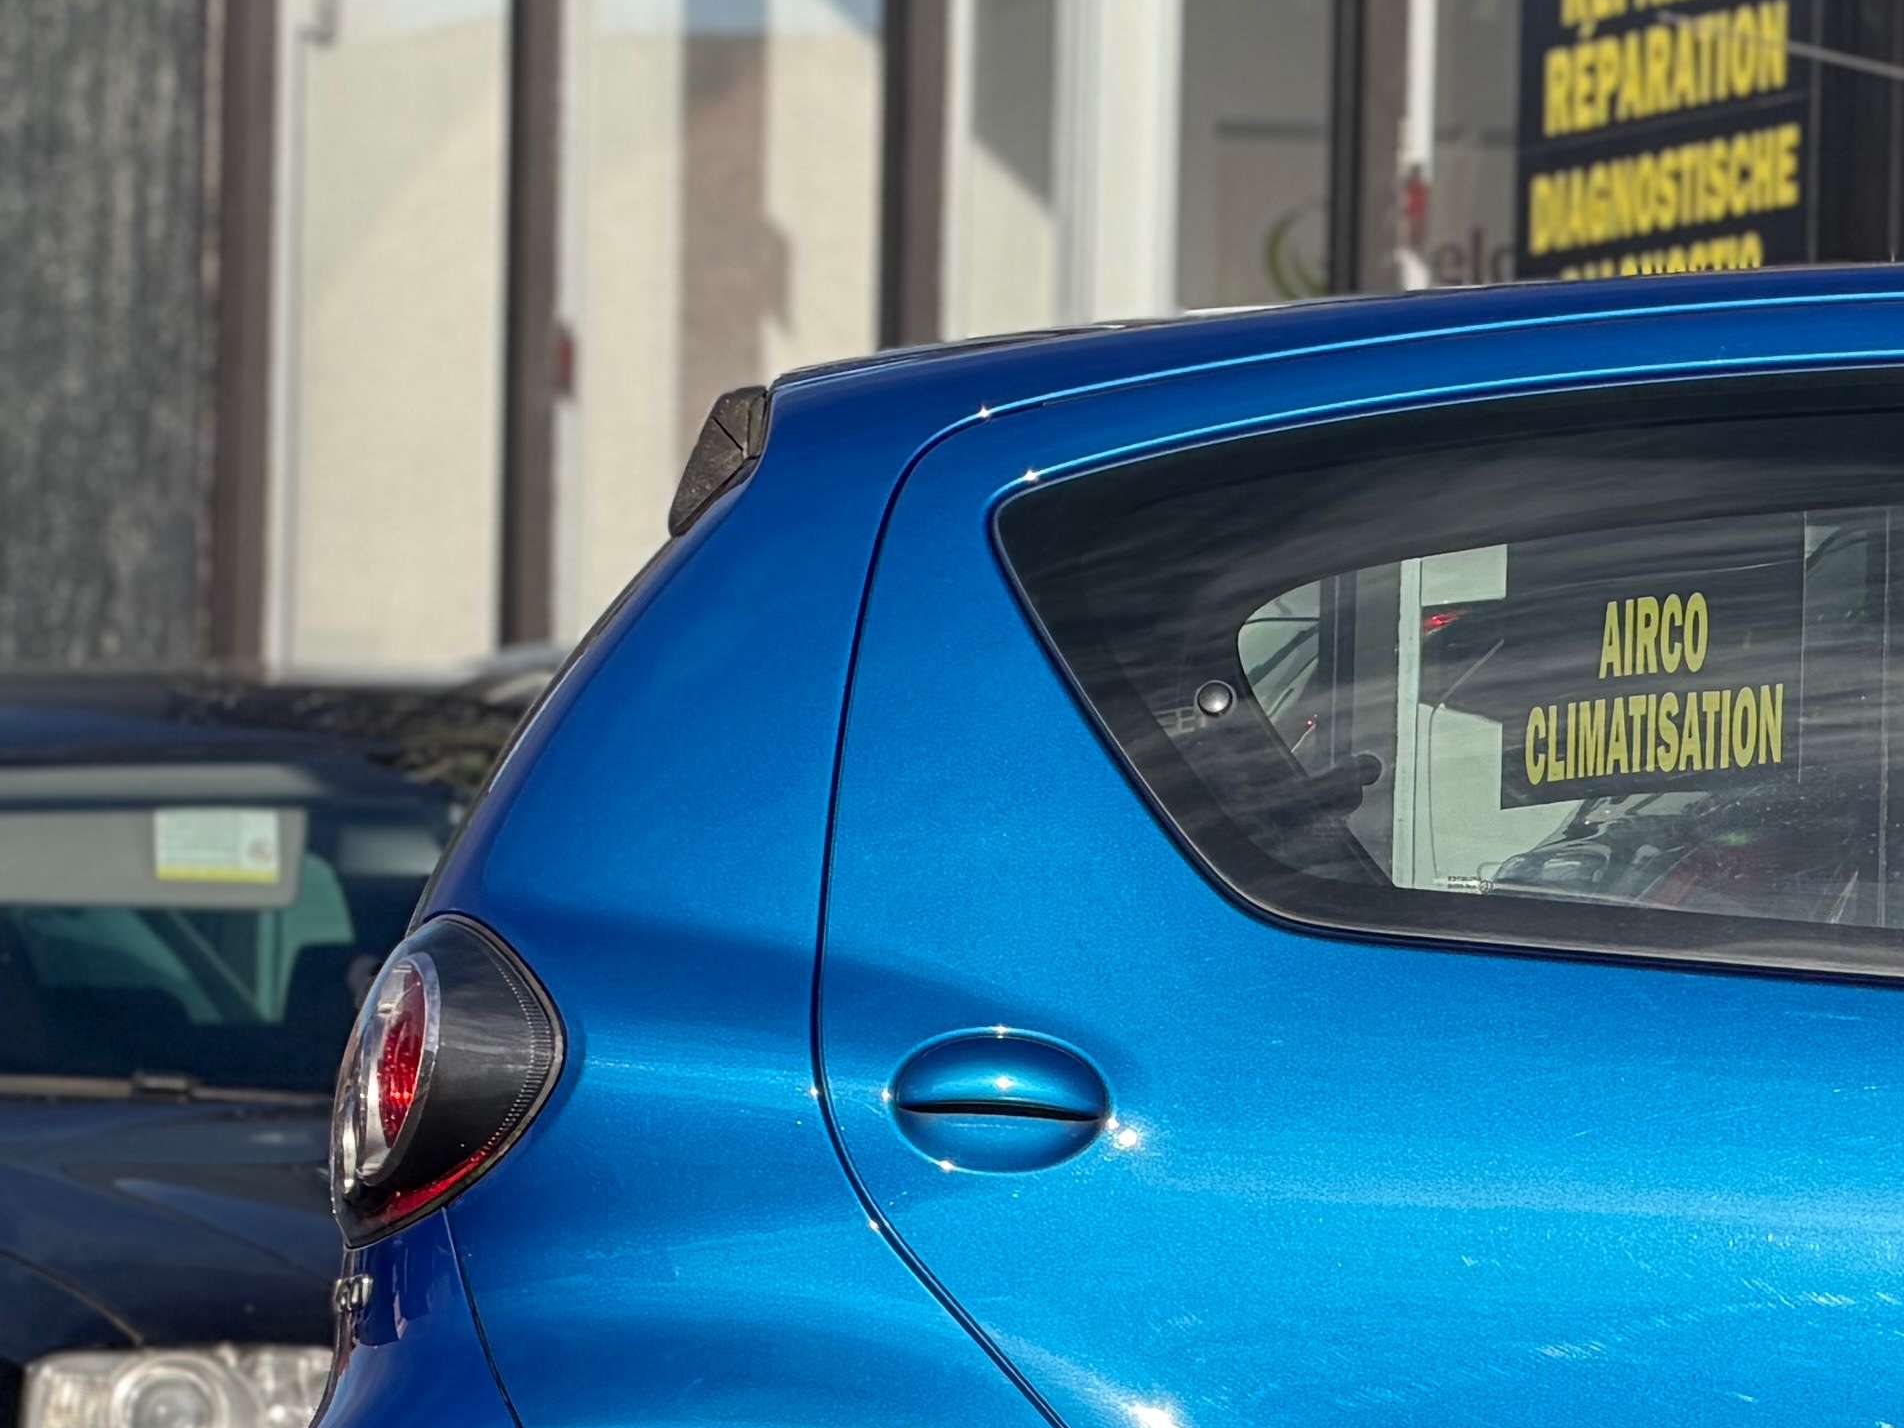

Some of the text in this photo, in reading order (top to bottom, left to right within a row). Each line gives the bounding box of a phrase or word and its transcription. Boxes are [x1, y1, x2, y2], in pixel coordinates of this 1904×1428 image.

[1529, 122, 1801, 258] DIAGNOSTISCHE
[1598, 590, 1709, 680] AIRCO
[1524, 682, 1784, 786] CLIMATISATION
